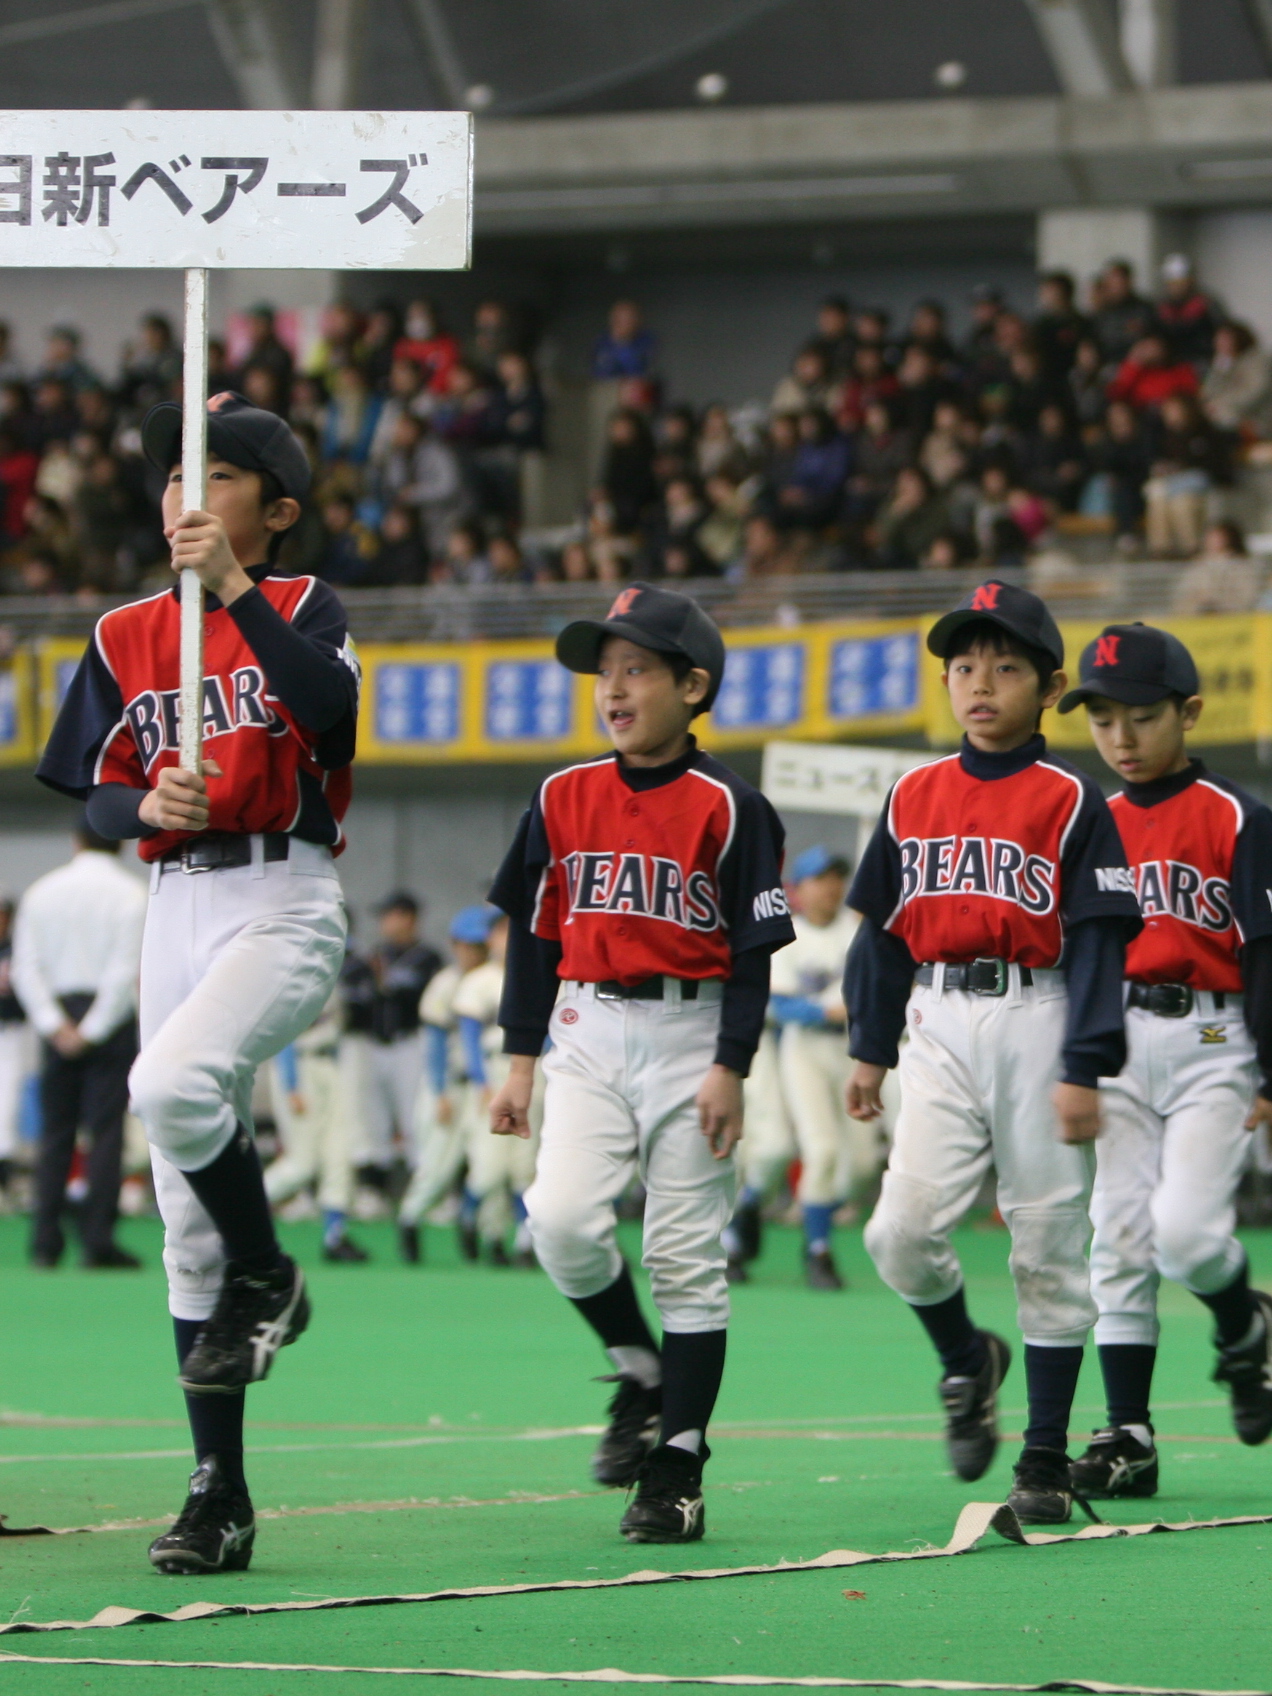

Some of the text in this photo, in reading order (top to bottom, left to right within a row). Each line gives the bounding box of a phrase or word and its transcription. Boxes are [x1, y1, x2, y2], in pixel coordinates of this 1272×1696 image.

[971, 583, 1001, 611] N
[1093, 635, 1121, 667] N
[900, 835, 1056, 916] BEARS
[1137, 859, 1234, 933] ARS
